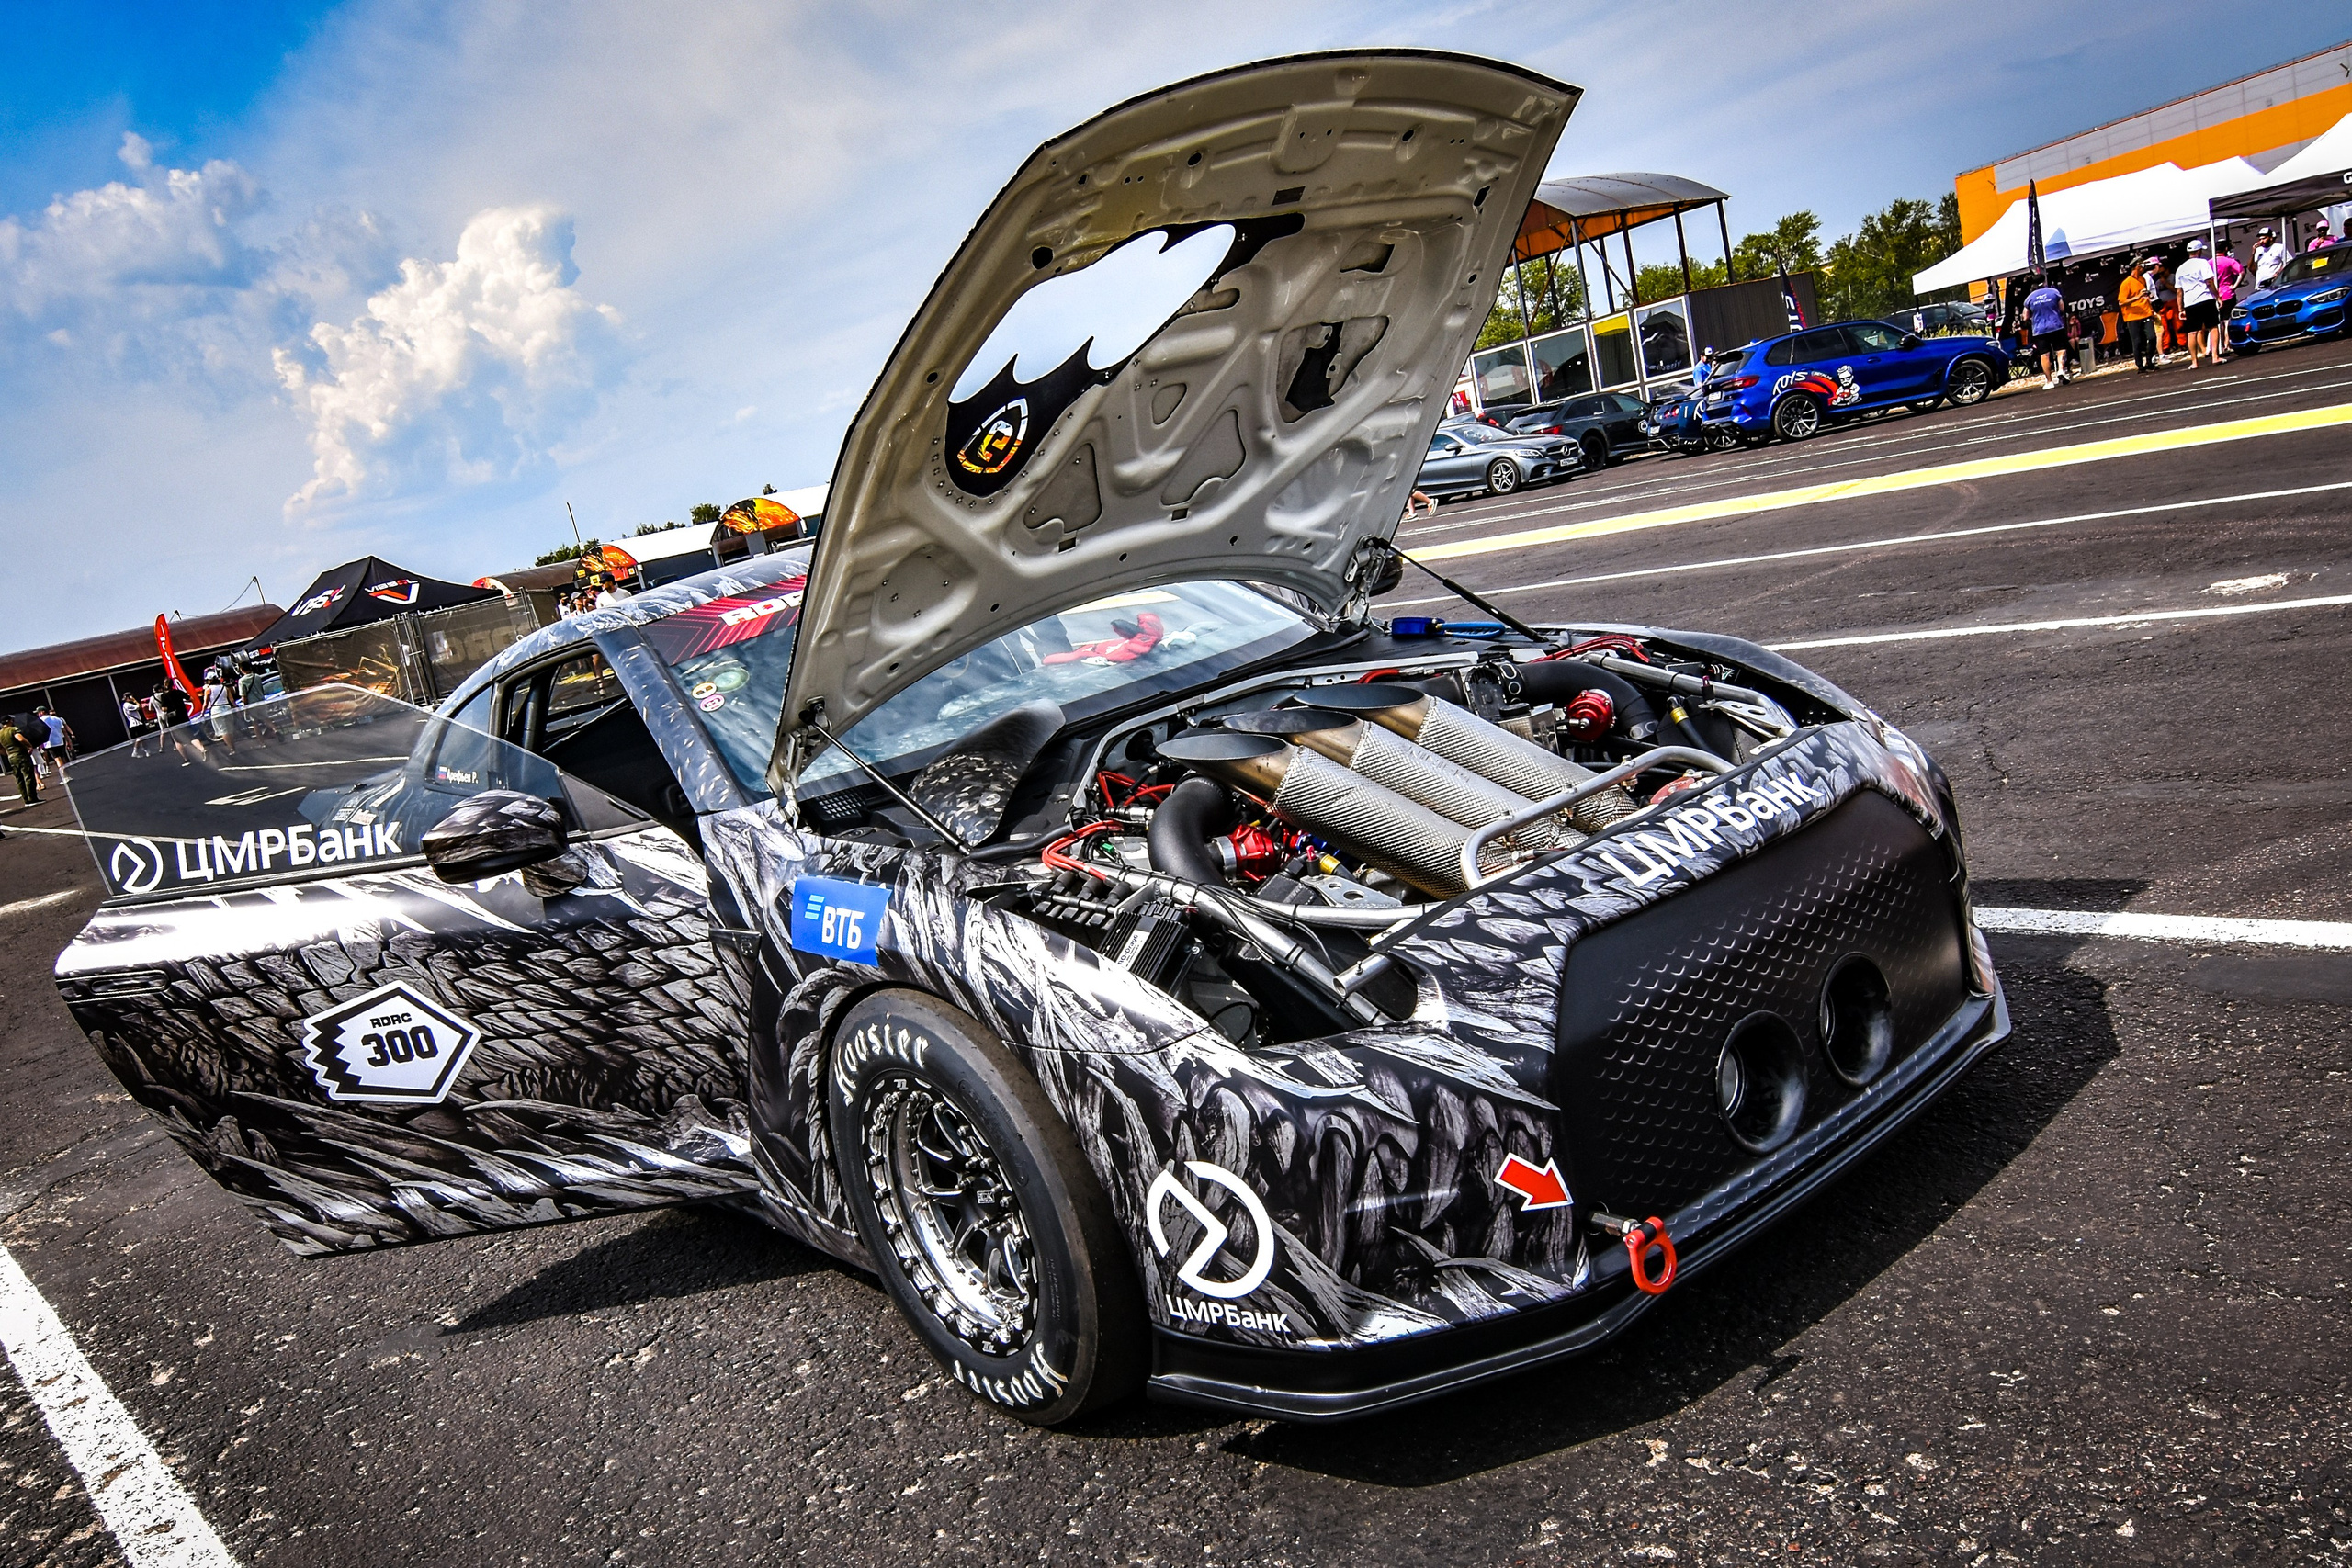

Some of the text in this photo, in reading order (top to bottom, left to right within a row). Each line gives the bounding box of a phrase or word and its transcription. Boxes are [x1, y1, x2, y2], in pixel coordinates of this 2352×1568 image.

[2068, 295, 2105, 312] TOYS
[1772, 370, 1809, 395] TOYS
[175, 820, 403, 882] ЦМРБанк
[1599, 772, 1824, 887] ЦМРБанк
[821, 906, 865, 950] ВТБ
[370, 1012, 413, 1029] RDRC
[361, 1025, 439, 1067] 300
[834, 1011, 929, 1107] Hoosier
[1165, 1294, 1291, 1333] ЦМРБанк
[954, 1341, 1069, 1407] Hoosier
